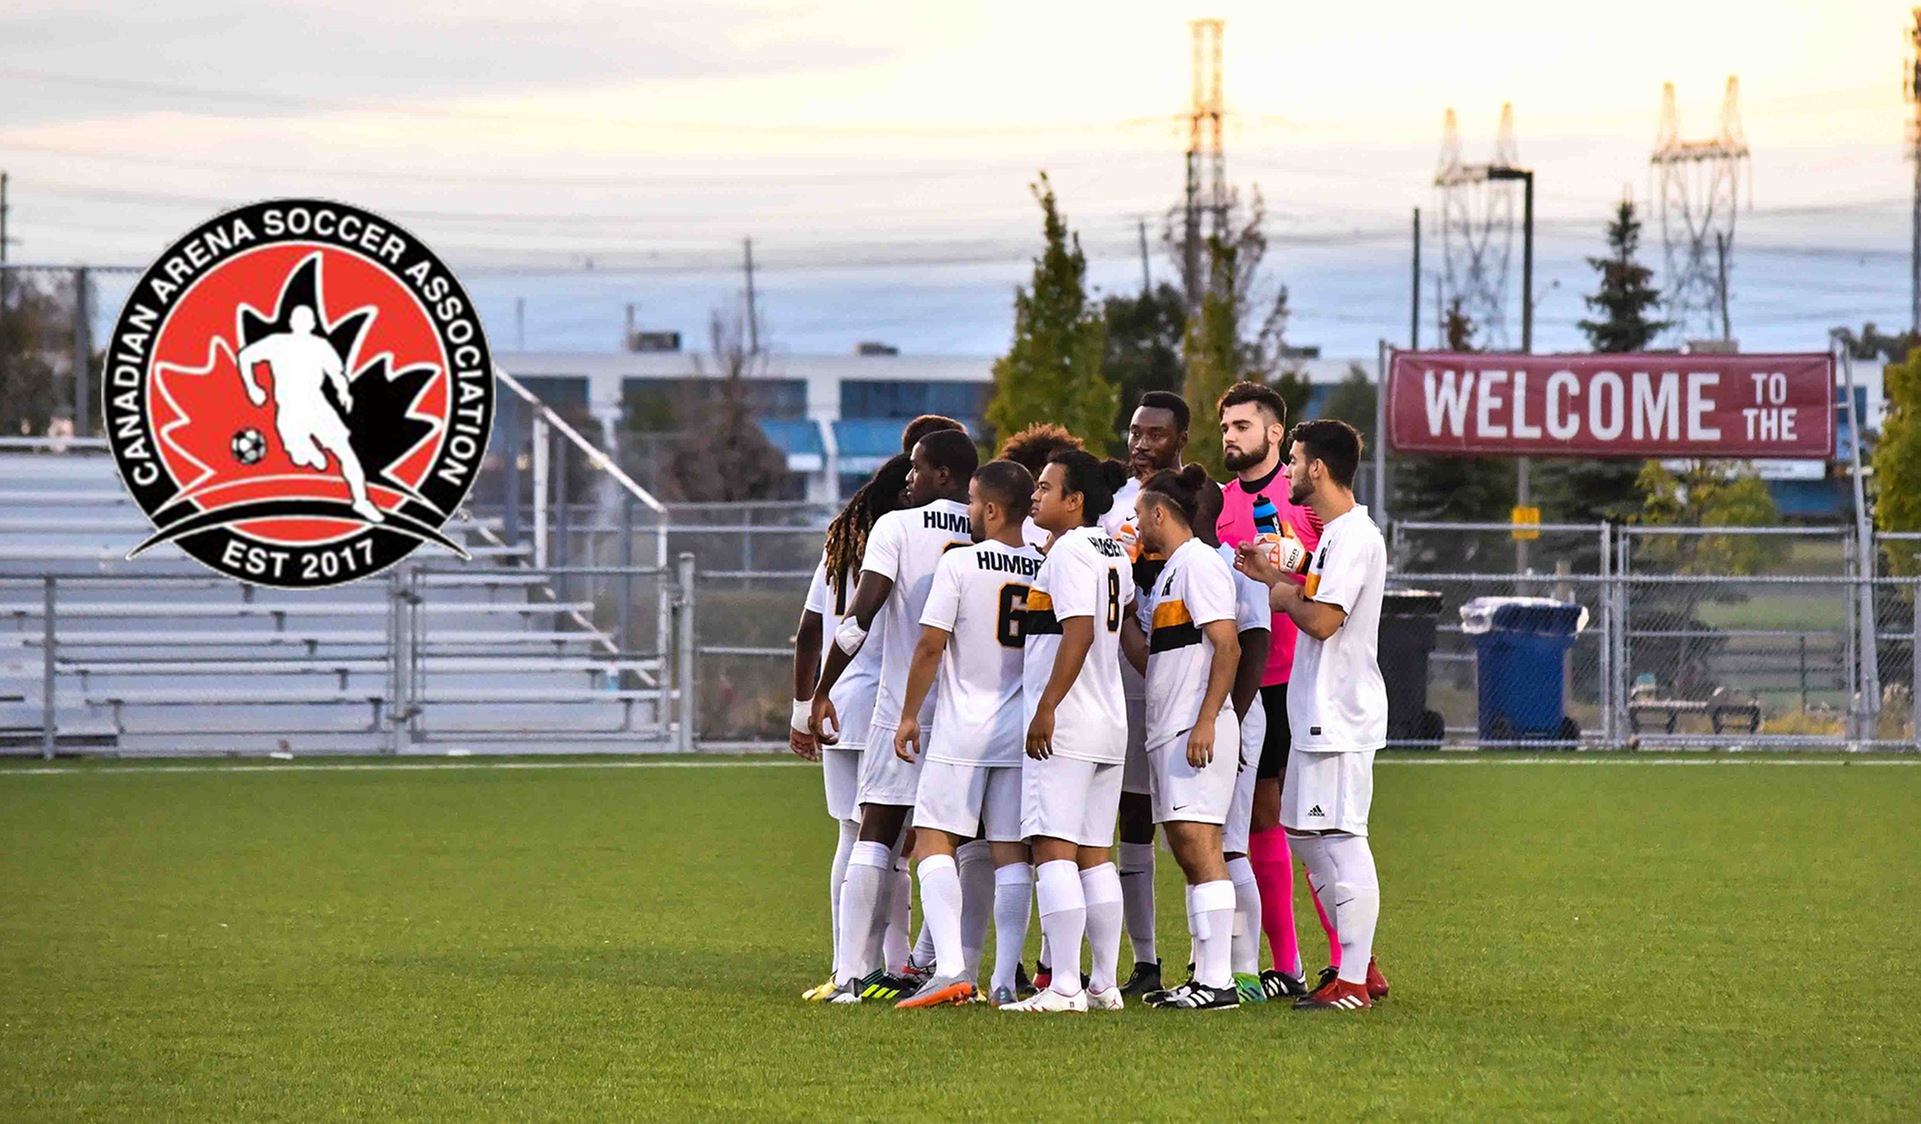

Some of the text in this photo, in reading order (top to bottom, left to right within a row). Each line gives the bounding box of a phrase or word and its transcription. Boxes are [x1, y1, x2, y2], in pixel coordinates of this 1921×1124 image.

[1424, 370, 1721, 442] WELCOME
[1751, 372, 1787, 405] TO
[1742, 408, 1798, 441] THE
[996, 581, 1030, 650] 6
[1105, 566, 1120, 634] 8
